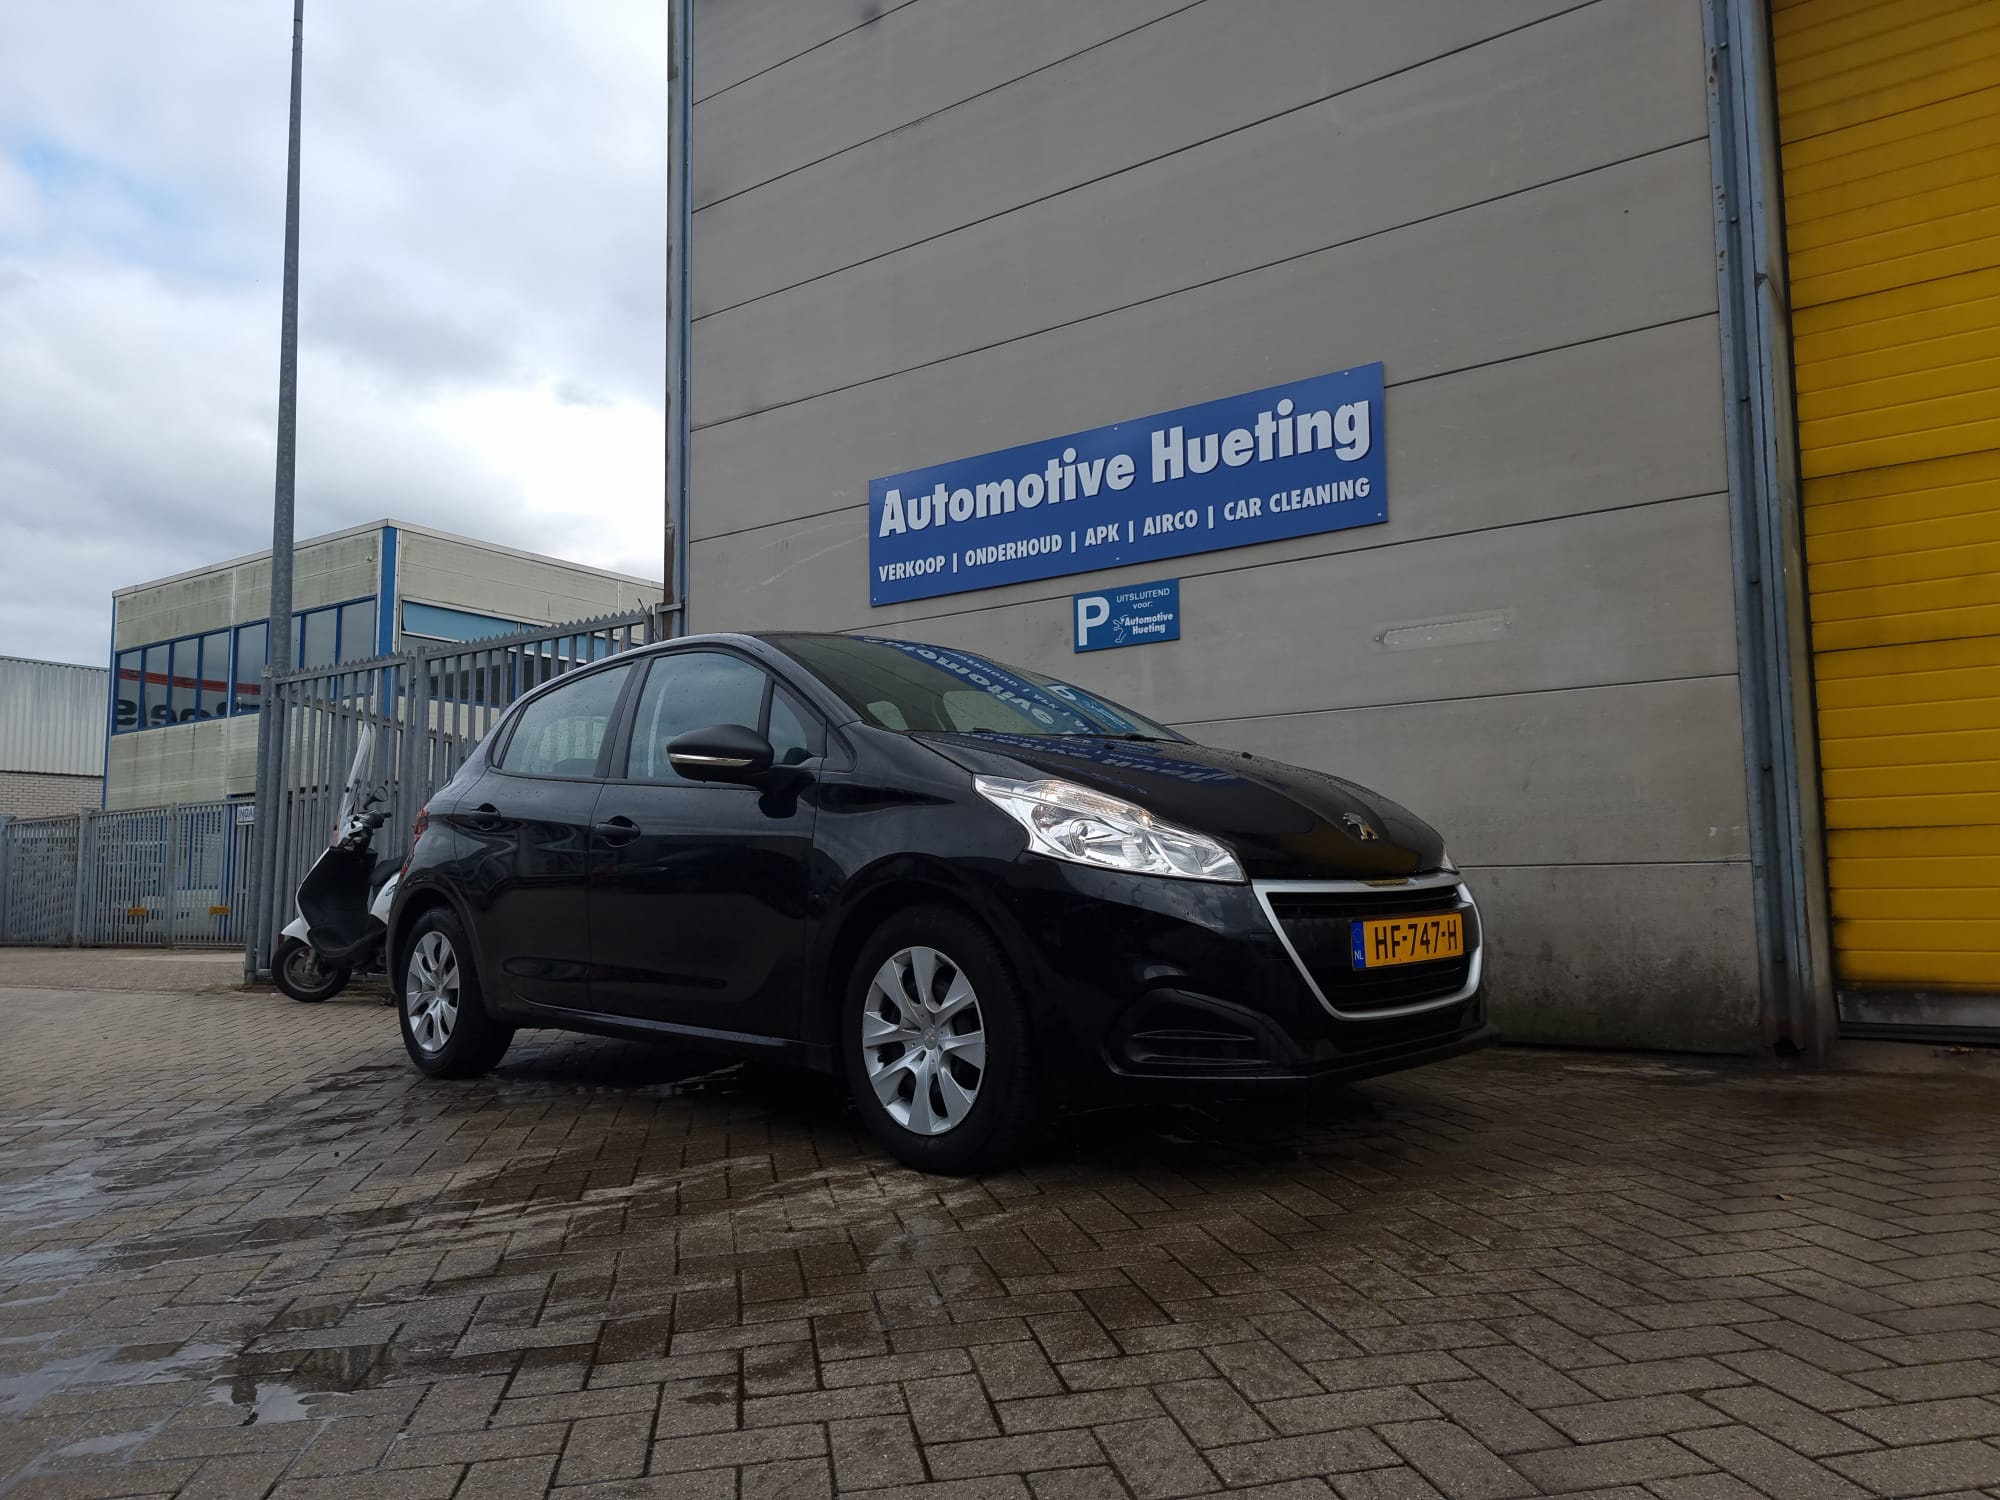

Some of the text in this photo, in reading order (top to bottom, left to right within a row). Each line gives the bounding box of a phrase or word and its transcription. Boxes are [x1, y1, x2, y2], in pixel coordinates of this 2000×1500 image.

[879, 398, 1370, 538] Automotive Hueting
[879, 477, 1370, 582] VERKOOP ONDERHOUD APK AIRCO CAR CLEANING
[1116, 587, 1170, 604] UITSLUITEND
[1132, 600, 1153, 610] voor:
[1077, 596, 1110, 647] P
[1124, 611, 1174, 627] Automotive
[1132, 622, 1166, 635] Hueting
[1374, 919, 1458, 960] HF-747-H
[1354, 950, 1364, 960] NL
